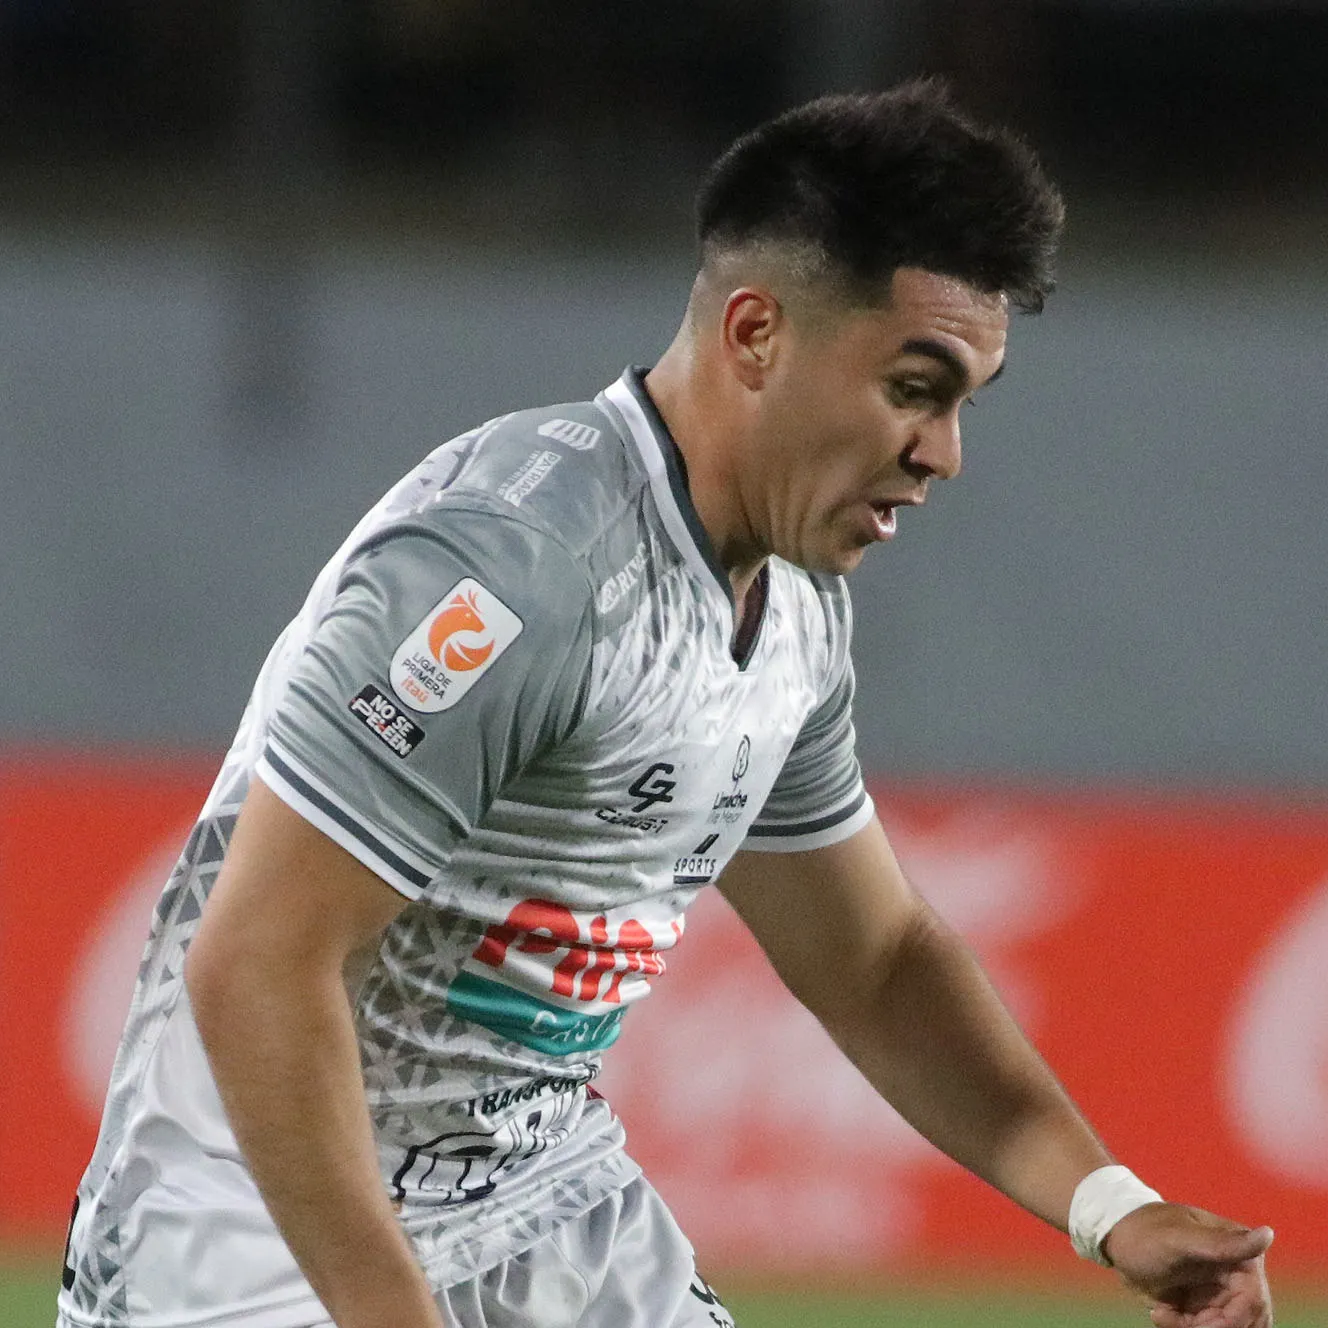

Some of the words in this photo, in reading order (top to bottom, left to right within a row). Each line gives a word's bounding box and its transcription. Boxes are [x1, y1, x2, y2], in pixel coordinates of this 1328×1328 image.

[402, 658, 446, 700] PRIMERA
[412, 651, 436, 676] LIGA
[434, 671, 452, 689] DE
[370, 694, 396, 720] NO
[391, 715, 414, 738] SE
[673, 857, 717, 874] SPORTS
